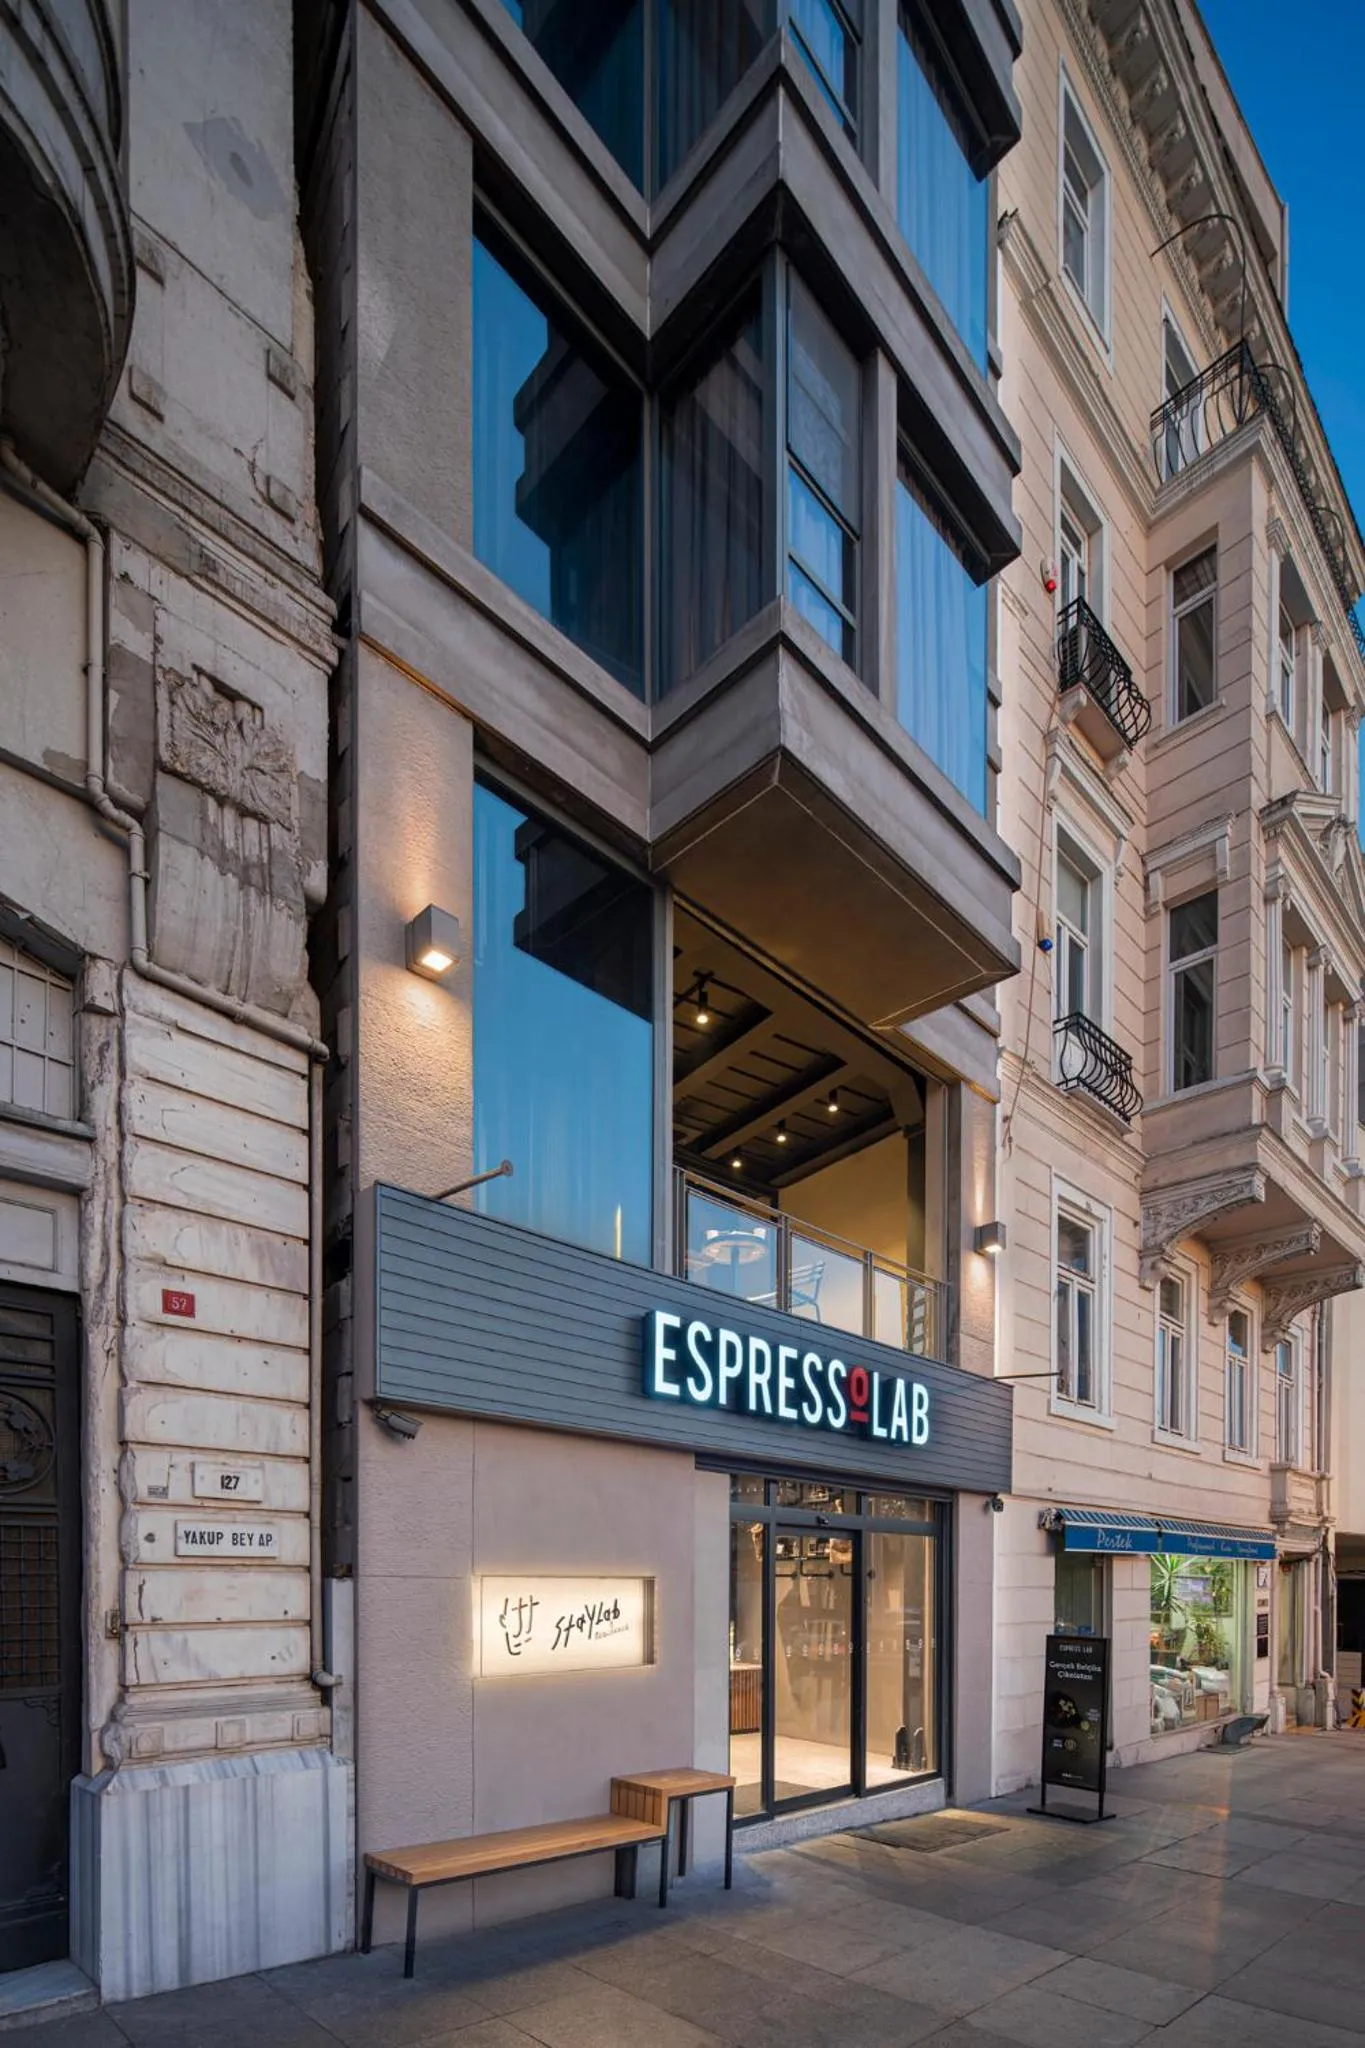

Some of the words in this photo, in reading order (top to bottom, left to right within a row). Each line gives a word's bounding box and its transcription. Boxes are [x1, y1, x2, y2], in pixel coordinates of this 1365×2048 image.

[653, 1310, 930, 1446] ESPRESSOLAB
[220, 1474, 240, 1491] 127
[183, 1530, 224, 1545] YAKUP
[231, 1532, 254, 1547] BEY
[258, 1533, 273, 1548] AP
[1097, 1528, 1133, 1550] Pertek
